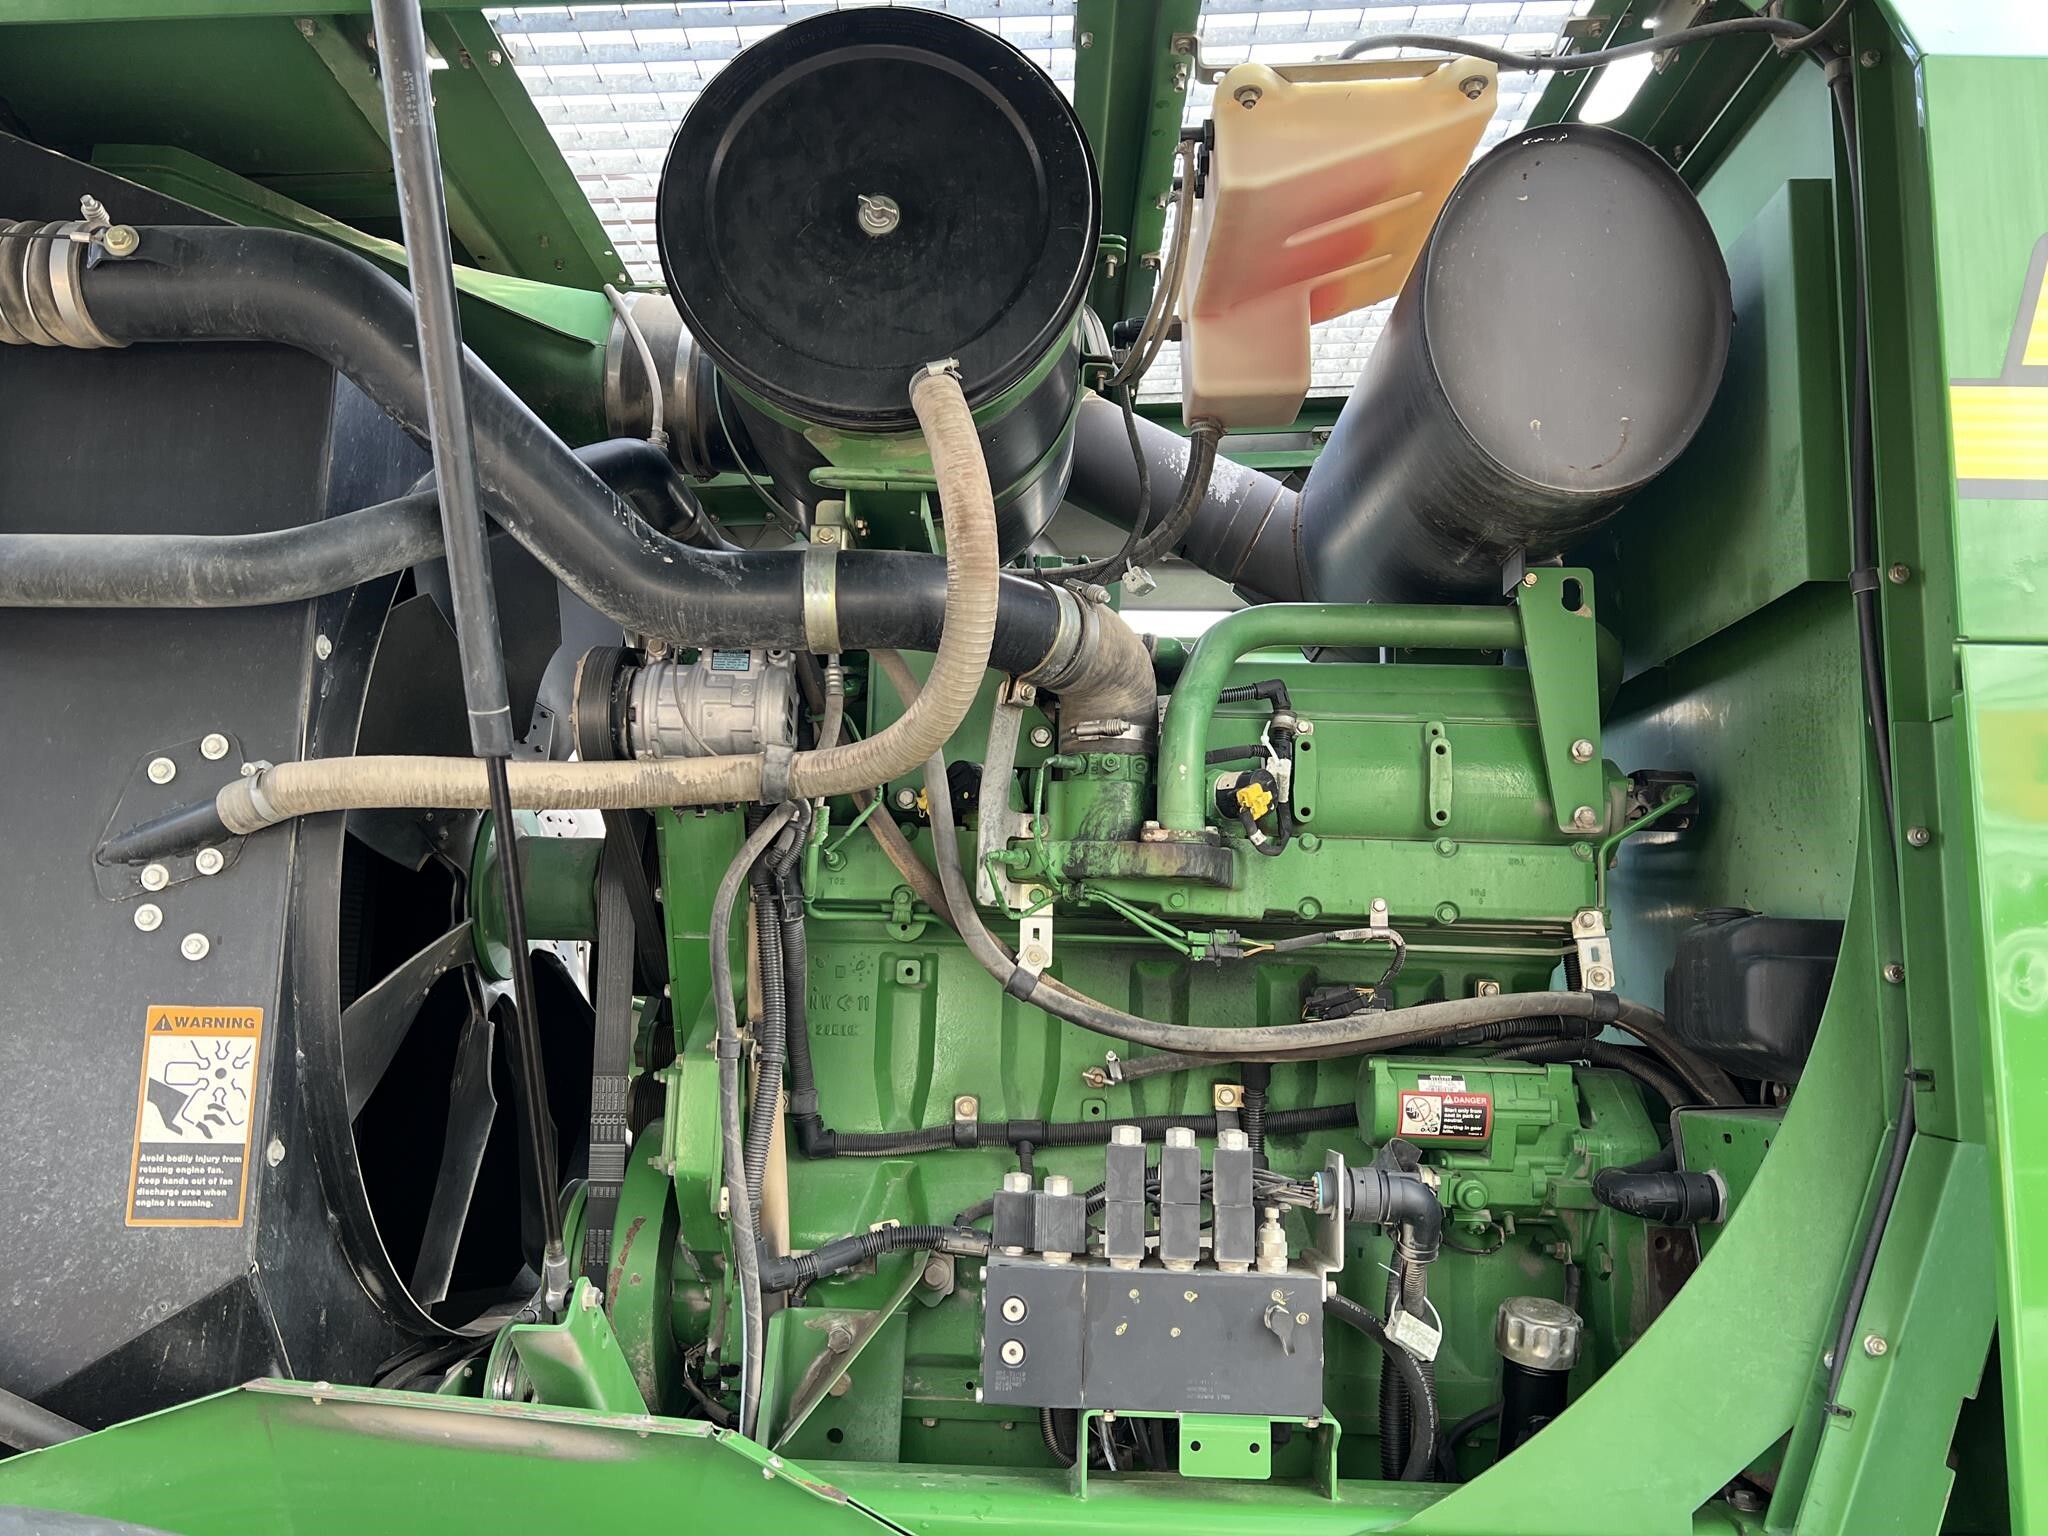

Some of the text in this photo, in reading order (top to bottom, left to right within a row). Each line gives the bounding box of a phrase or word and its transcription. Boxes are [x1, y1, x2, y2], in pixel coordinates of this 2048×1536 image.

[174, 1016, 255, 1029] WARNING
[1453, 1096, 1487, 1104] DANGER
[140, 1153, 242, 1164] Avoid bodily injury from
[139, 1165, 224, 1175] rotating engine fan.
[138, 1176, 234, 1186] Keep hands out of fan
[136, 1187, 227, 1197] discharge area when
[135, 1198, 214, 1208] engine is running.
